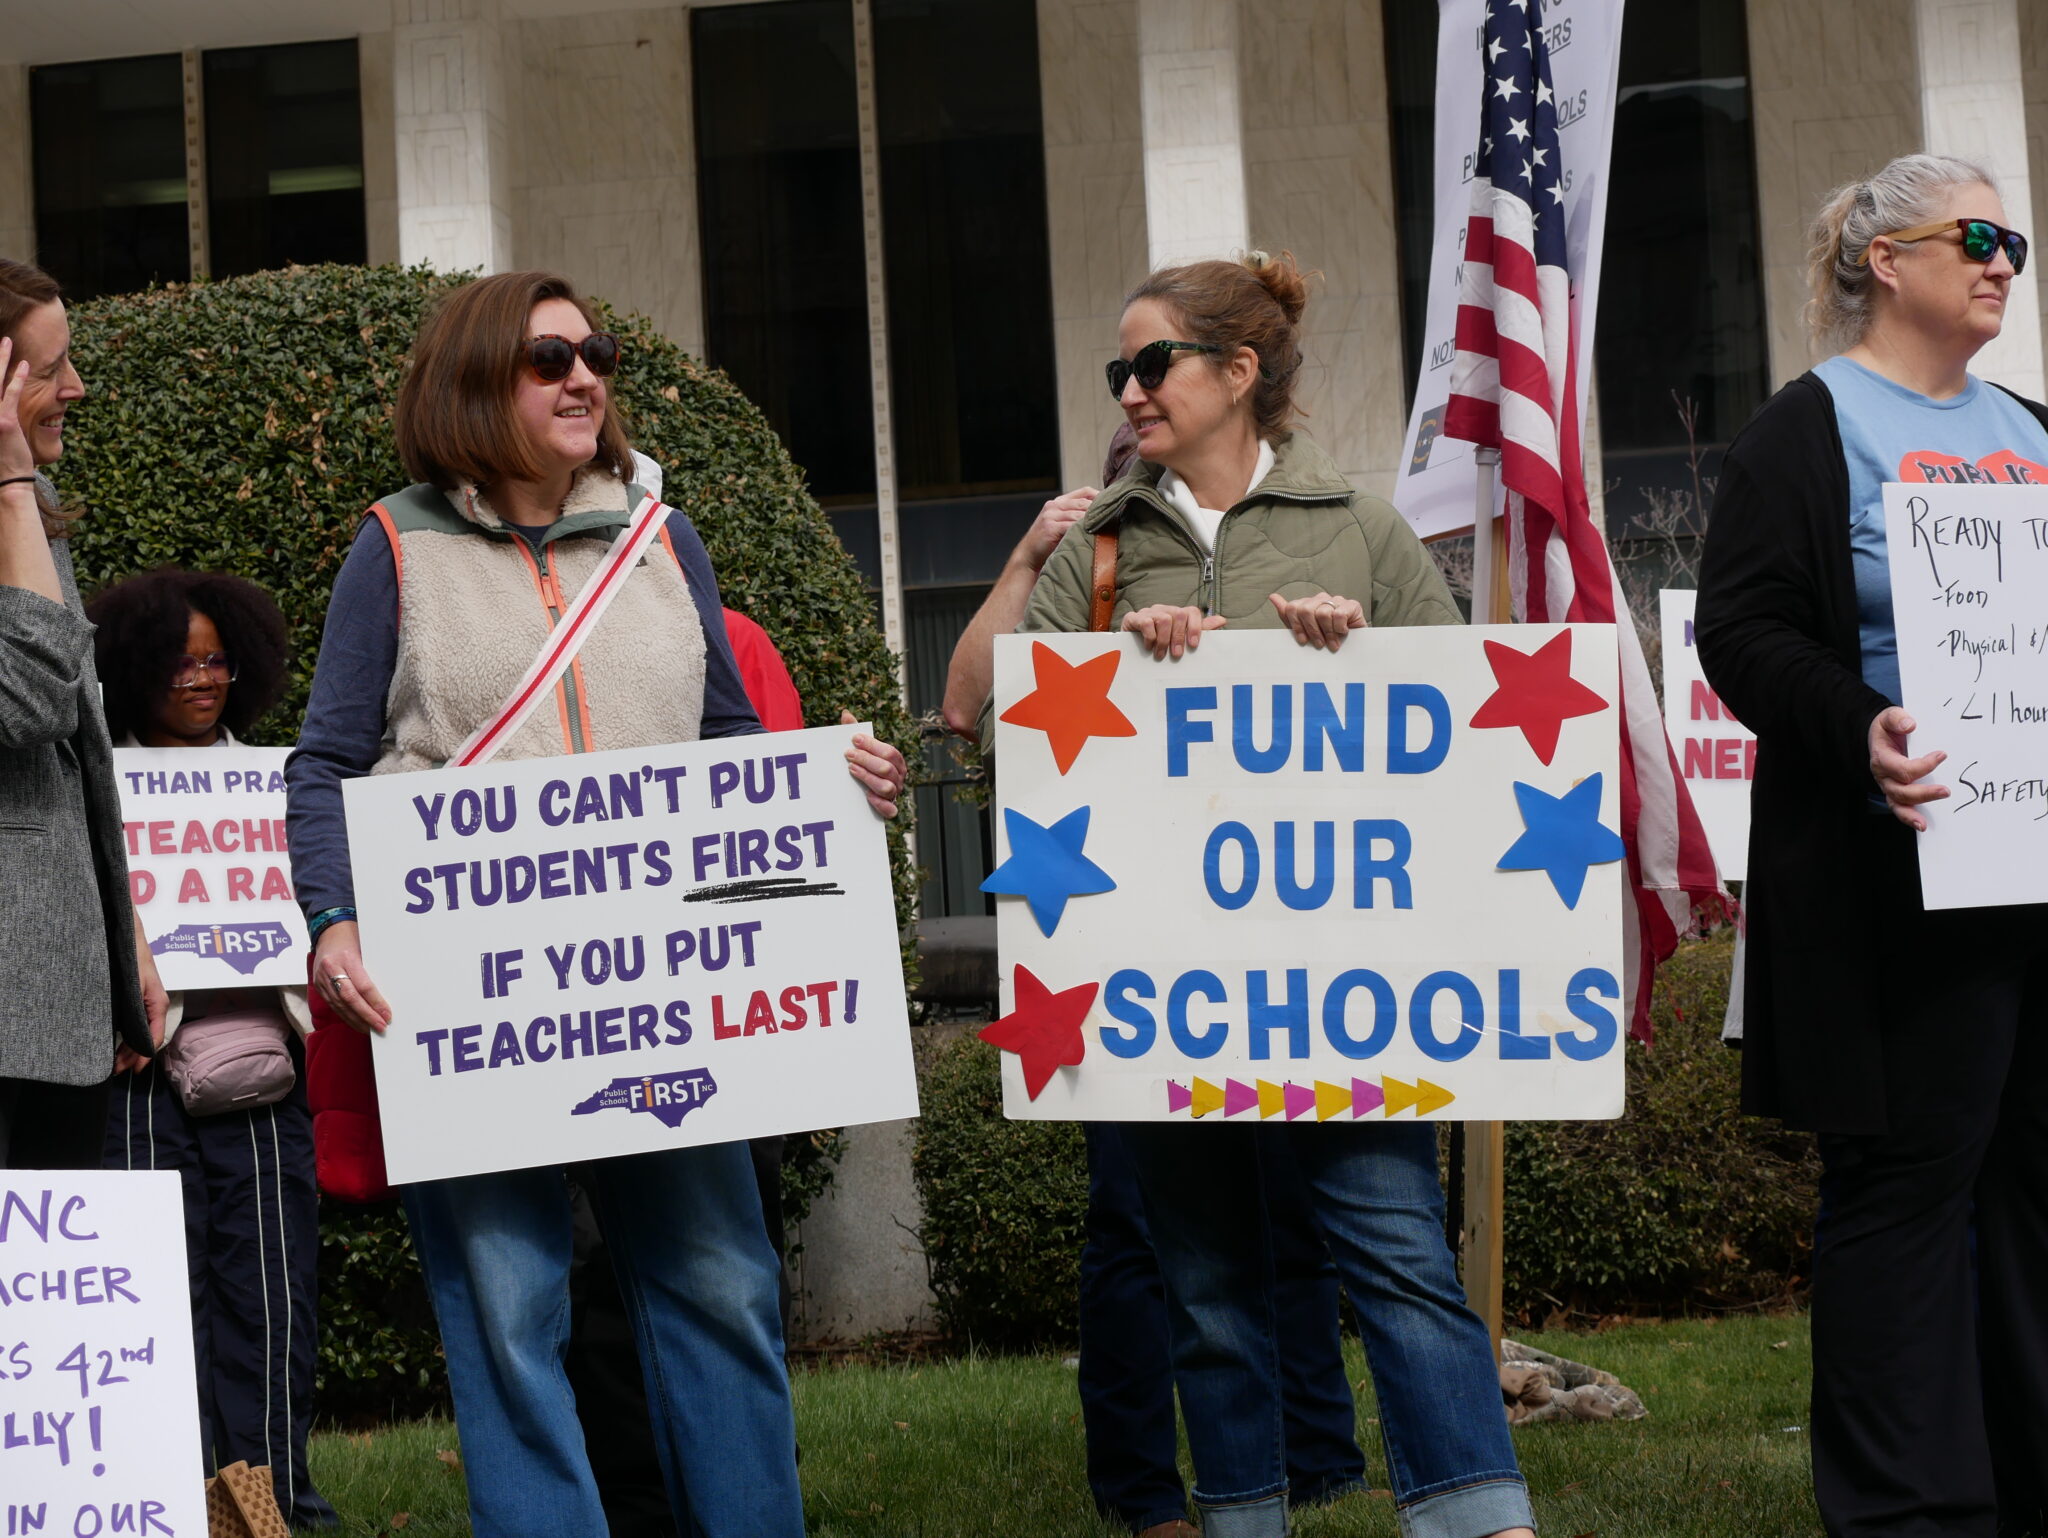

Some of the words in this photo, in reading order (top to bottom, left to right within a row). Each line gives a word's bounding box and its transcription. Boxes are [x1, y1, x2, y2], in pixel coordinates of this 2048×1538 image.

[1906, 496, 2002, 588] READY
[1165, 682, 1452, 777] FUND
[125, 770, 213, 794] THAN
[413, 785, 517, 841] YOU
[539, 764, 687, 826] CAN'T
[709, 753, 807, 809] PUT
[1953, 760, 2048, 821] SAFETY
[177, 868, 211, 903] A
[226, 866, 298, 902] RA
[404, 840, 672, 914] STUDENTS
[692, 821, 834, 882] FIRST
[1203, 819, 1413, 911] OUR
[164, 942, 196, 950] Schools
[275, 937, 289, 945] NC
[169, 934, 196, 942] Public
[481, 949, 523, 999] IF
[545, 935, 645, 990] YOU
[666, 921, 762, 976] PUT
[416, 1000, 692, 1076] TEACHERS
[711, 979, 859, 1041] LAST!
[1100, 967, 1621, 1062] SCHOOLS
[599, 1097, 629, 1107] Schools
[701, 1084, 714, 1092] NC
[604, 1089, 628, 1097] Public
[0, 1189, 99, 1243] NC
[56, 1337, 154, 1398] 42nd
[8, 1502, 47, 1536] IN
[73, 1500, 175, 1538] OUR
